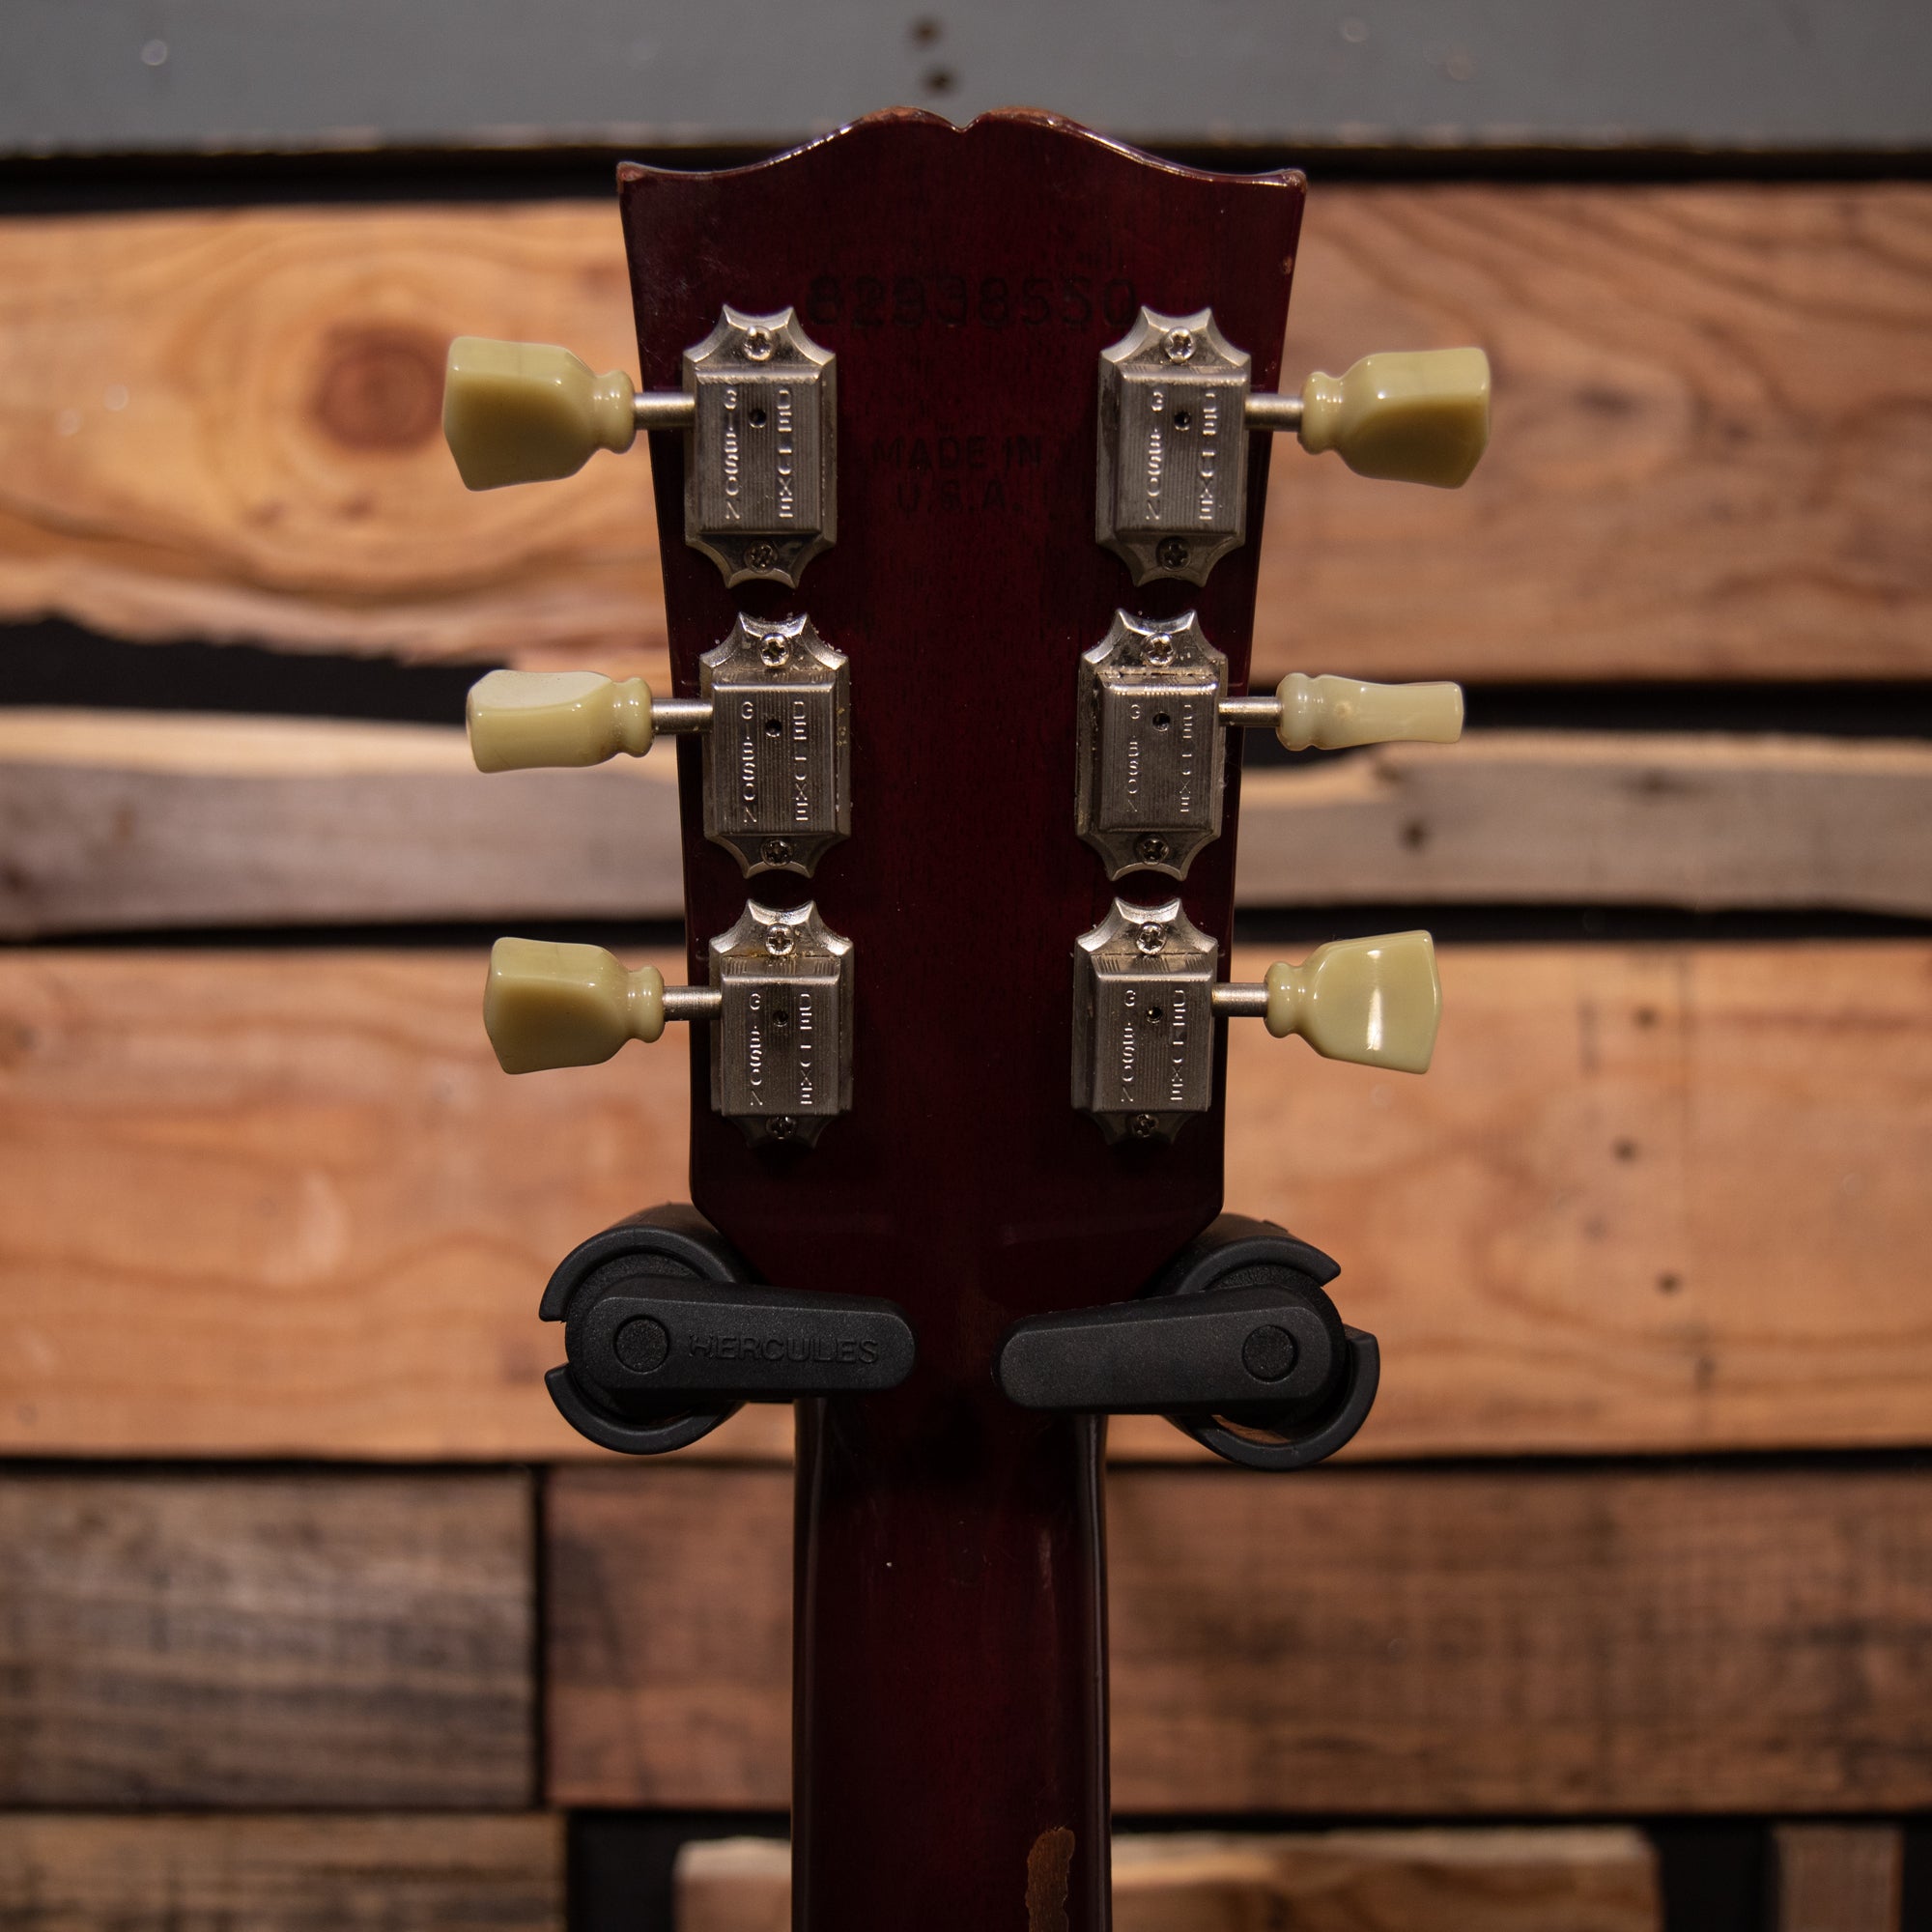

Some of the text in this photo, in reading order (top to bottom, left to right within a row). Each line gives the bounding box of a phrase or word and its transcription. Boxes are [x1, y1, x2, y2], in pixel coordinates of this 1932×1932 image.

[724, 389, 741, 520] GIBSON
[777, 389, 794, 518] DELUXE
[870, 435, 1042, 469] MADE IN
[1146, 391, 1163, 521] GIBSON
[1199, 392, 1218, 520] DELUXE
[741, 700, 757, 823] GIBSON
[793, 700, 810, 821] DELUXE
[1125, 703, 1142, 812] GIBSON
[1179, 703, 1193, 813] DELUXE
[749, 992, 764, 1106] GIBSON
[798, 993, 813, 1105] DELUXE
[1121, 989, 1137, 1103] GIBSON
[1170, 989, 1186, 1100] DELUXE
[689, 1335, 879, 1365] HERCULES
